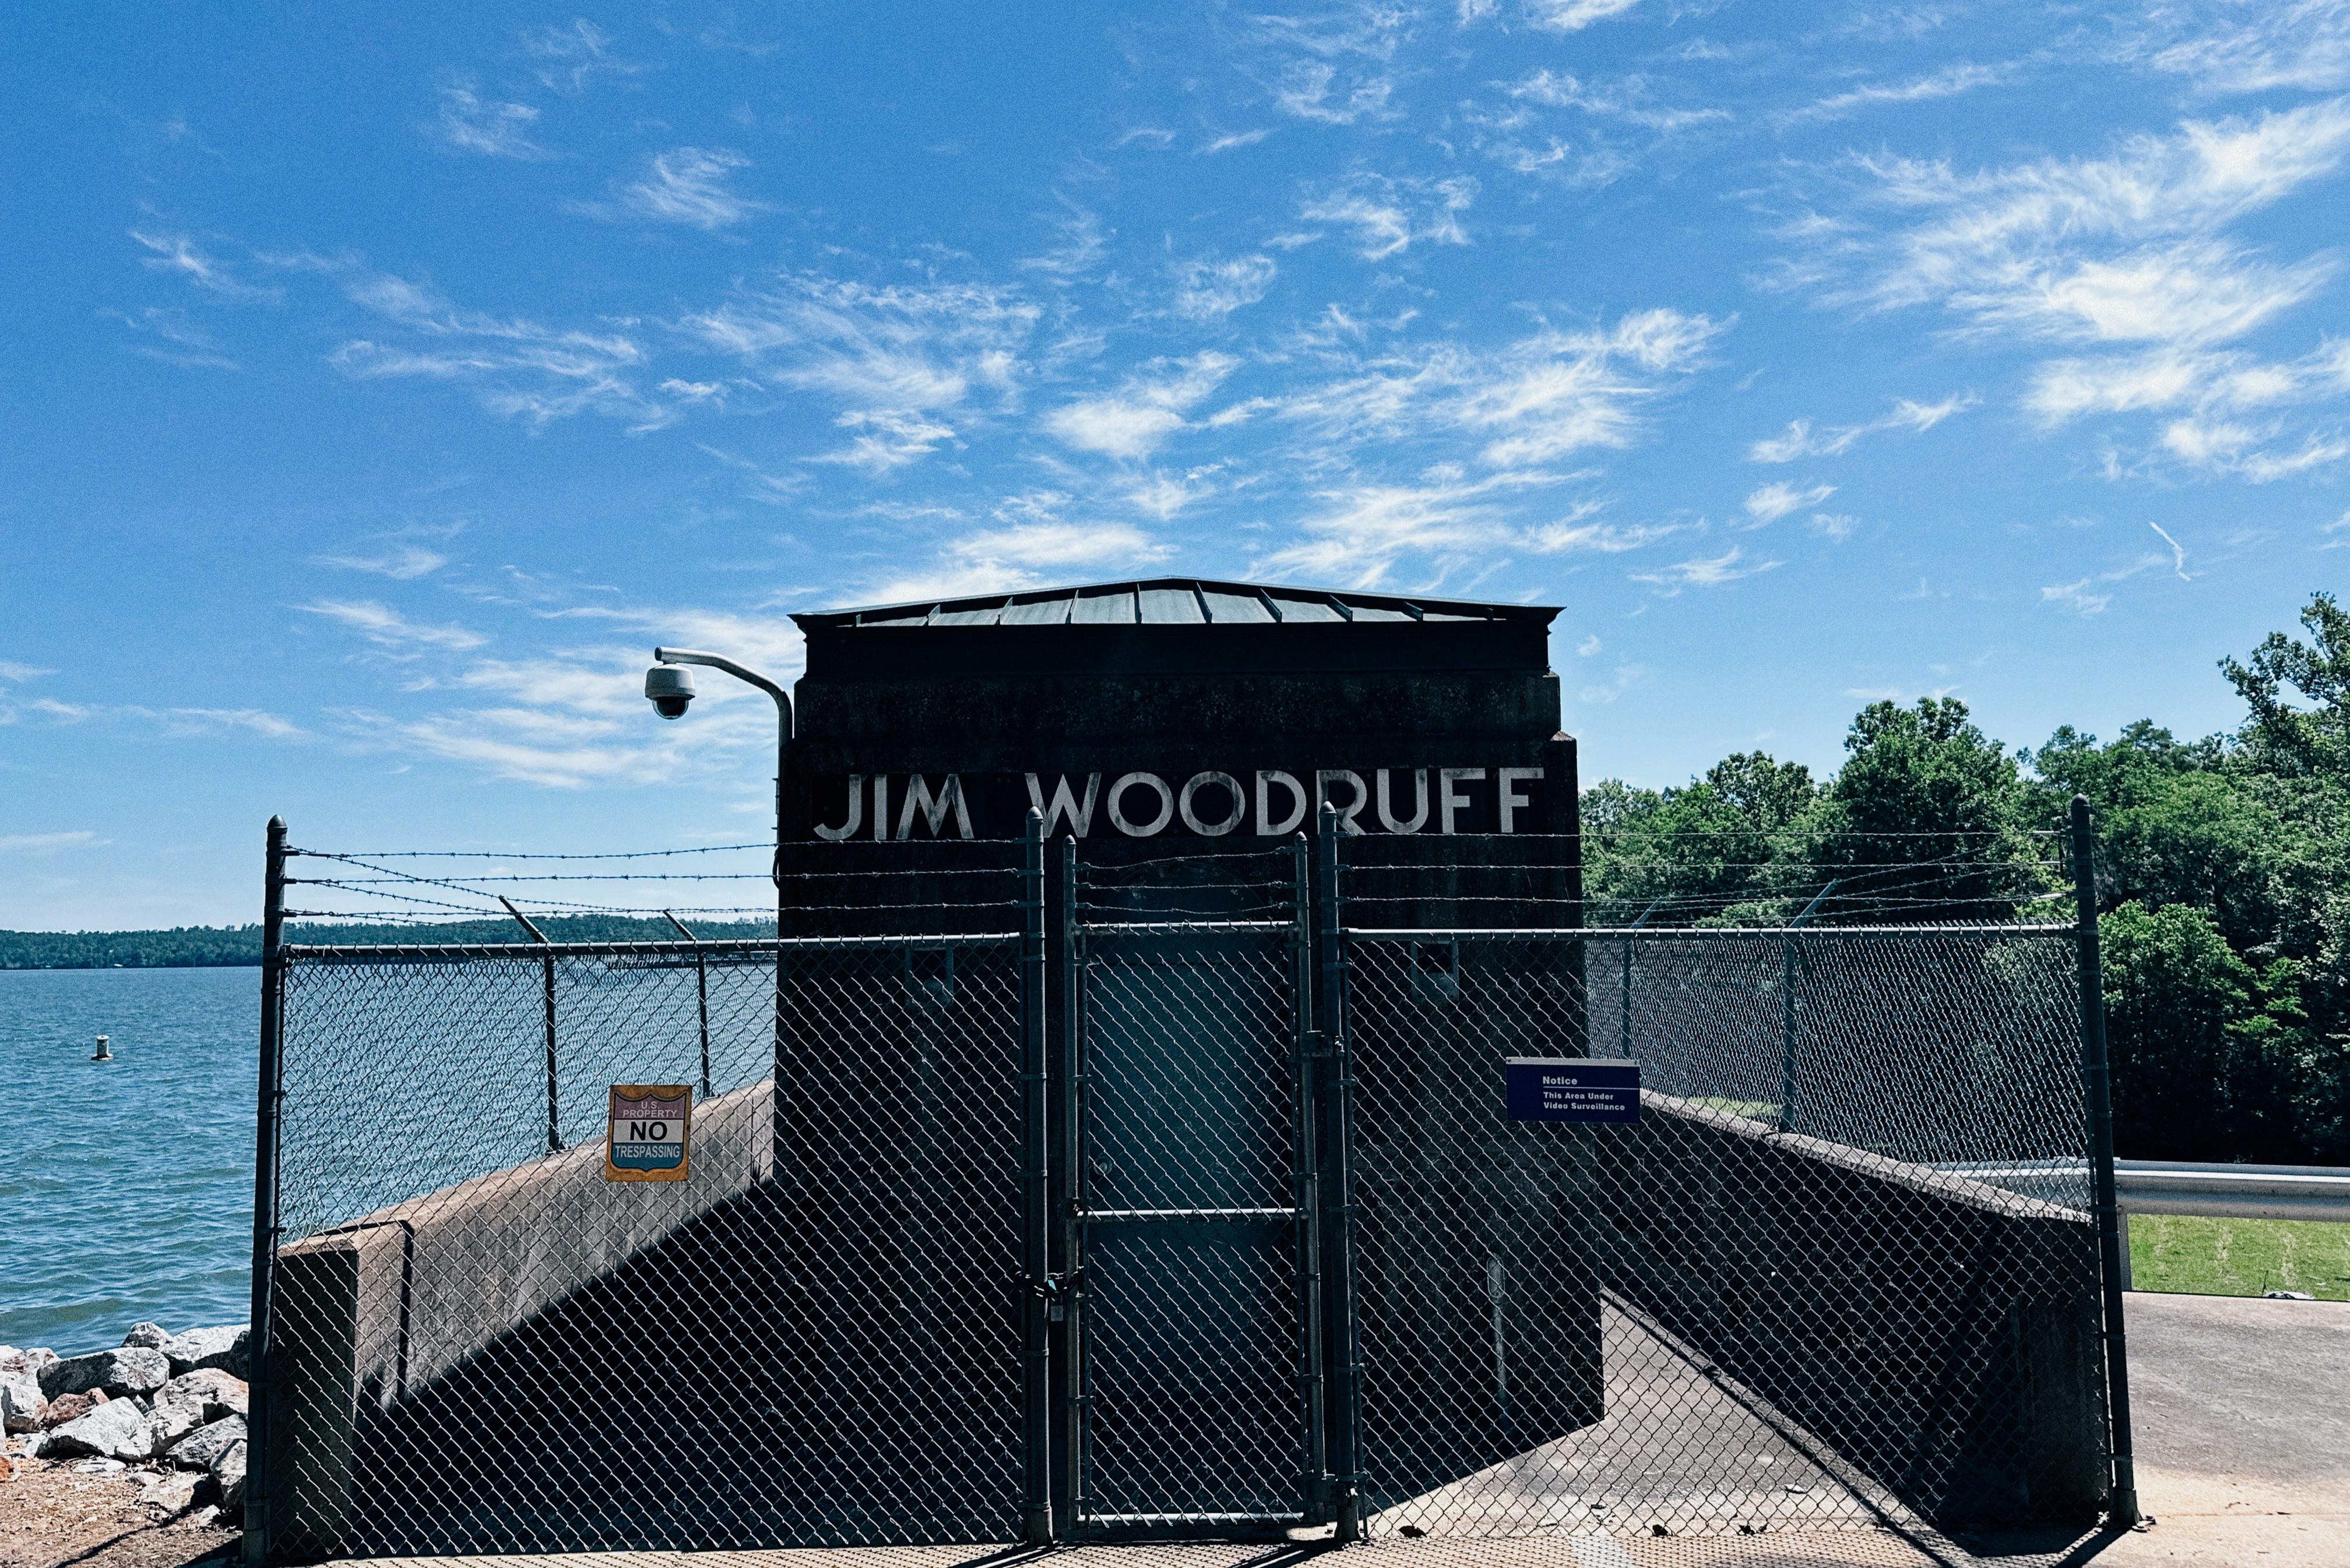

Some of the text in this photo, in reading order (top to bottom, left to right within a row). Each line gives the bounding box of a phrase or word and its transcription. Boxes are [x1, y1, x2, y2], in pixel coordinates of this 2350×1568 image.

[813, 766, 1545, 840] JIM WOODRUFF
[1543, 1076, 1578, 1085] Notice
[1543, 1091, 1562, 1100] This
[1571, 1102, 1626, 1111] Surveillance
[622, 1109, 677, 1118] PROPERTY
[630, 1121, 668, 1141] NO
[615, 1146, 680, 1158] TRESPASSING
